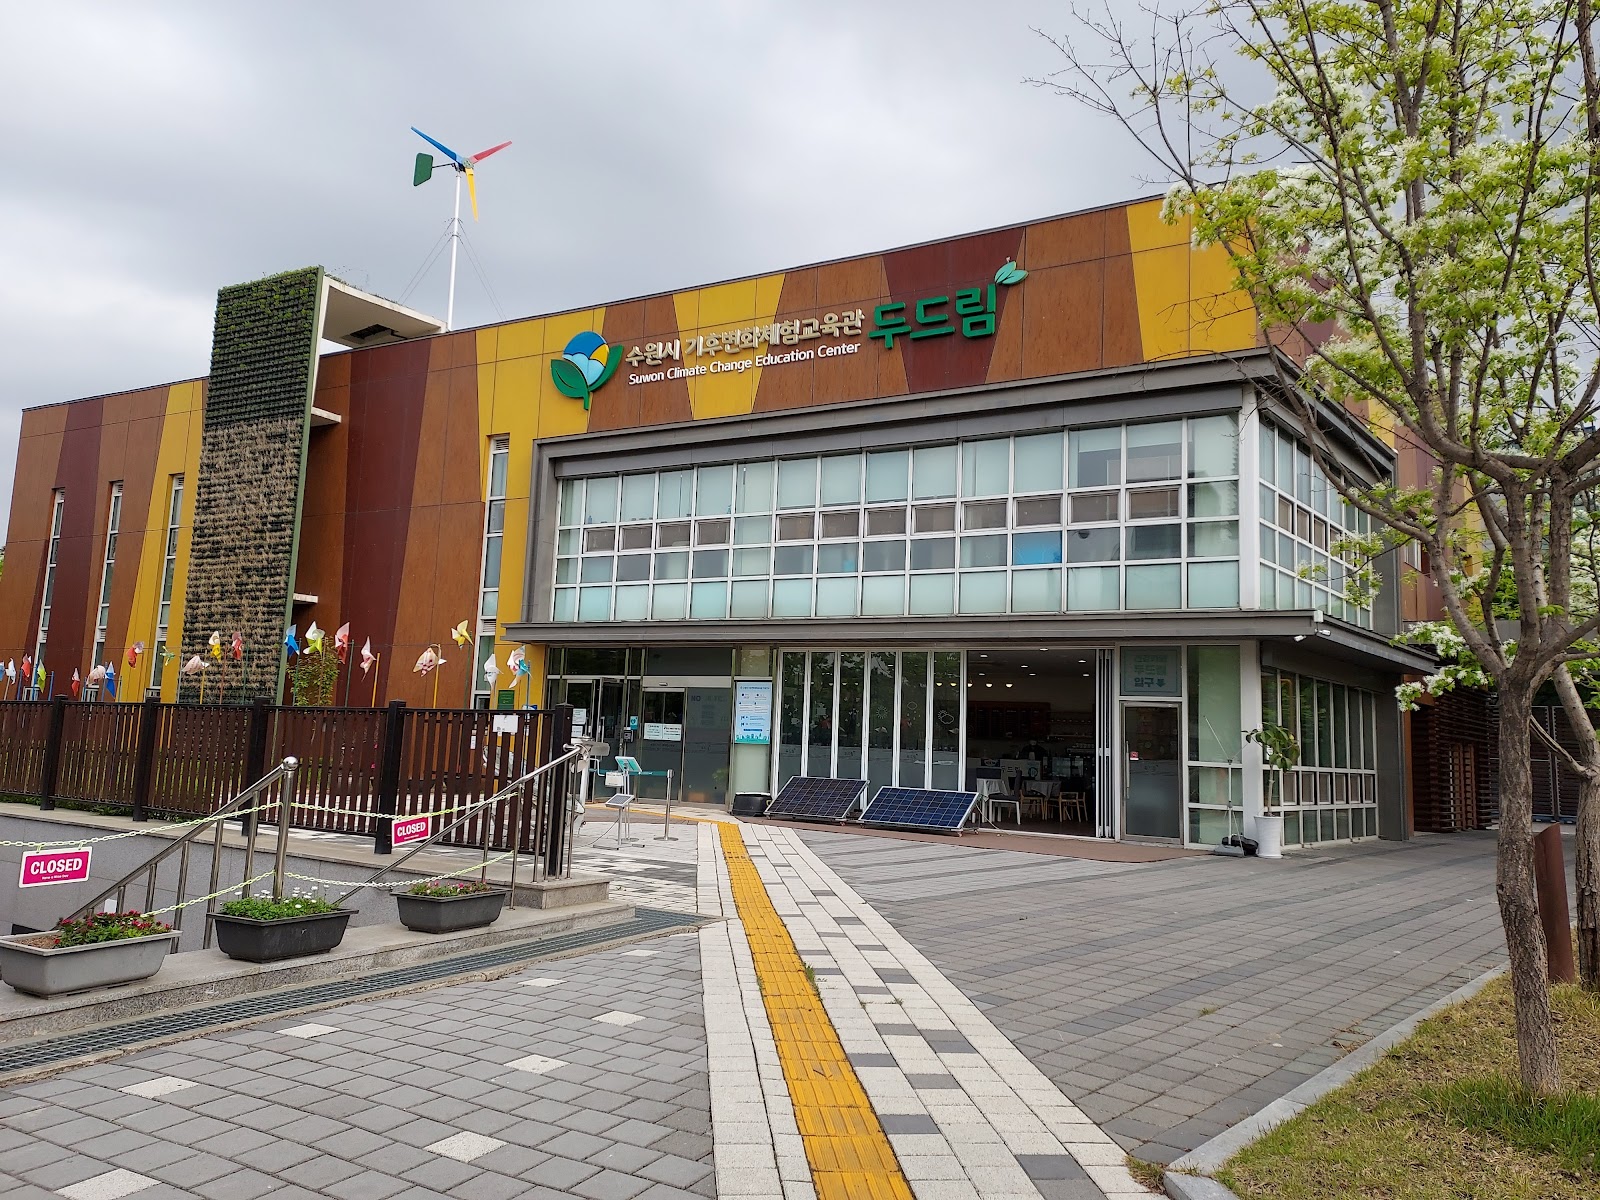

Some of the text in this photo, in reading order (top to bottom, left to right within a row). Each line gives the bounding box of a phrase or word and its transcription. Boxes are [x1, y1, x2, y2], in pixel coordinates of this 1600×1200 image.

[625, 283, 997, 367] 수원시 기후변화체험교육관 두드림
[628, 341, 861, 385] Suwon Climate Change Education Center
[1134, 677, 1154, 688] 입구
[397, 821, 426, 837] CLOSED
[30, 858, 83, 875] CLOSED
